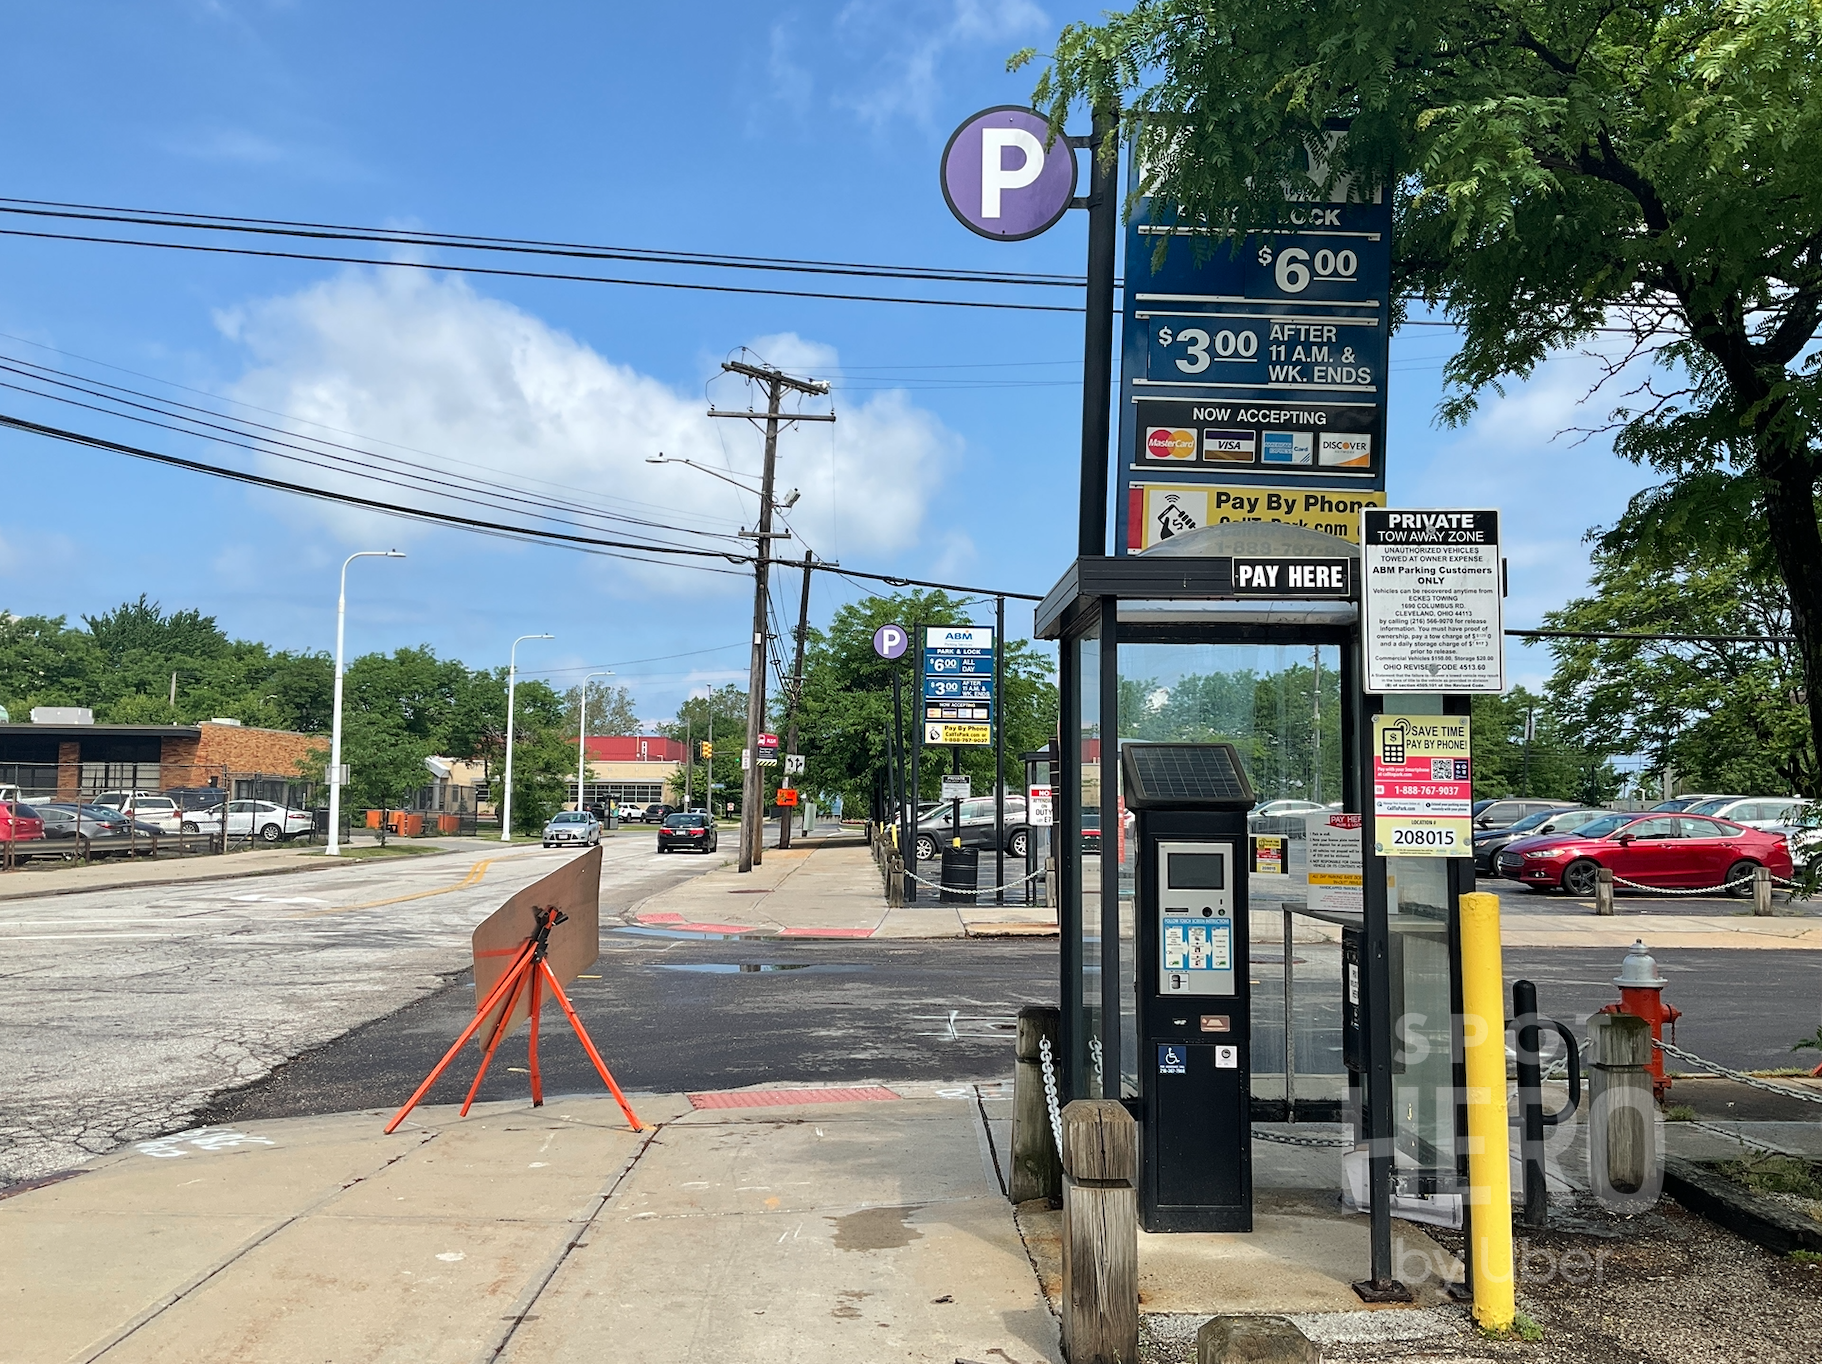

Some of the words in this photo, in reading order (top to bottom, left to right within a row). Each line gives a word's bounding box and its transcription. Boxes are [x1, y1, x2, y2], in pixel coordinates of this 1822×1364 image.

[981, 128, 1044, 218] P
[1269, 325, 1337, 343] AFTER
[1269, 345, 1289, 364] 11
[1291, 345, 1334, 364] A.M.
[1341, 345, 1356, 364] &
[1269, 364, 1308, 385] WK.
[1313, 364, 1372, 385] ENDS
[1193, 407, 1231, 421] NOW
[1237, 409, 1327, 425] ACCEPTING
[1149, 438, 1194, 449] MasterCard
[1218, 441, 1241, 450] VISA
[1323, 441, 1367, 451] DISCOVER
[1216, 491, 1259, 513] Pay
[1267, 493, 1297, 514] By
[1304, 495, 1378, 514] Phone
[1389, 514, 1474, 528] PRIVATE
[1377, 531, 1407, 542] TOW
[1409, 531, 1445, 542] AWAY
[1448, 531, 1484, 542] ZONE
[1239, 565, 1280, 587] PAY
[1288, 565, 1343, 587] HERE
[1398, 567, 1436, 575] Parking
[883, 630, 900, 654] P
[1412, 726, 1438, 737] SAVE
[1441, 726, 1464, 737] TIME
[1406, 740, 1422, 749] PAY
[1425, 741, 1435, 749] BY
[1437, 740, 1467, 750] PHONE!
[1395, 786, 1459, 795] 1-888-767-9037
[1394, 830, 1454, 845] 208015
